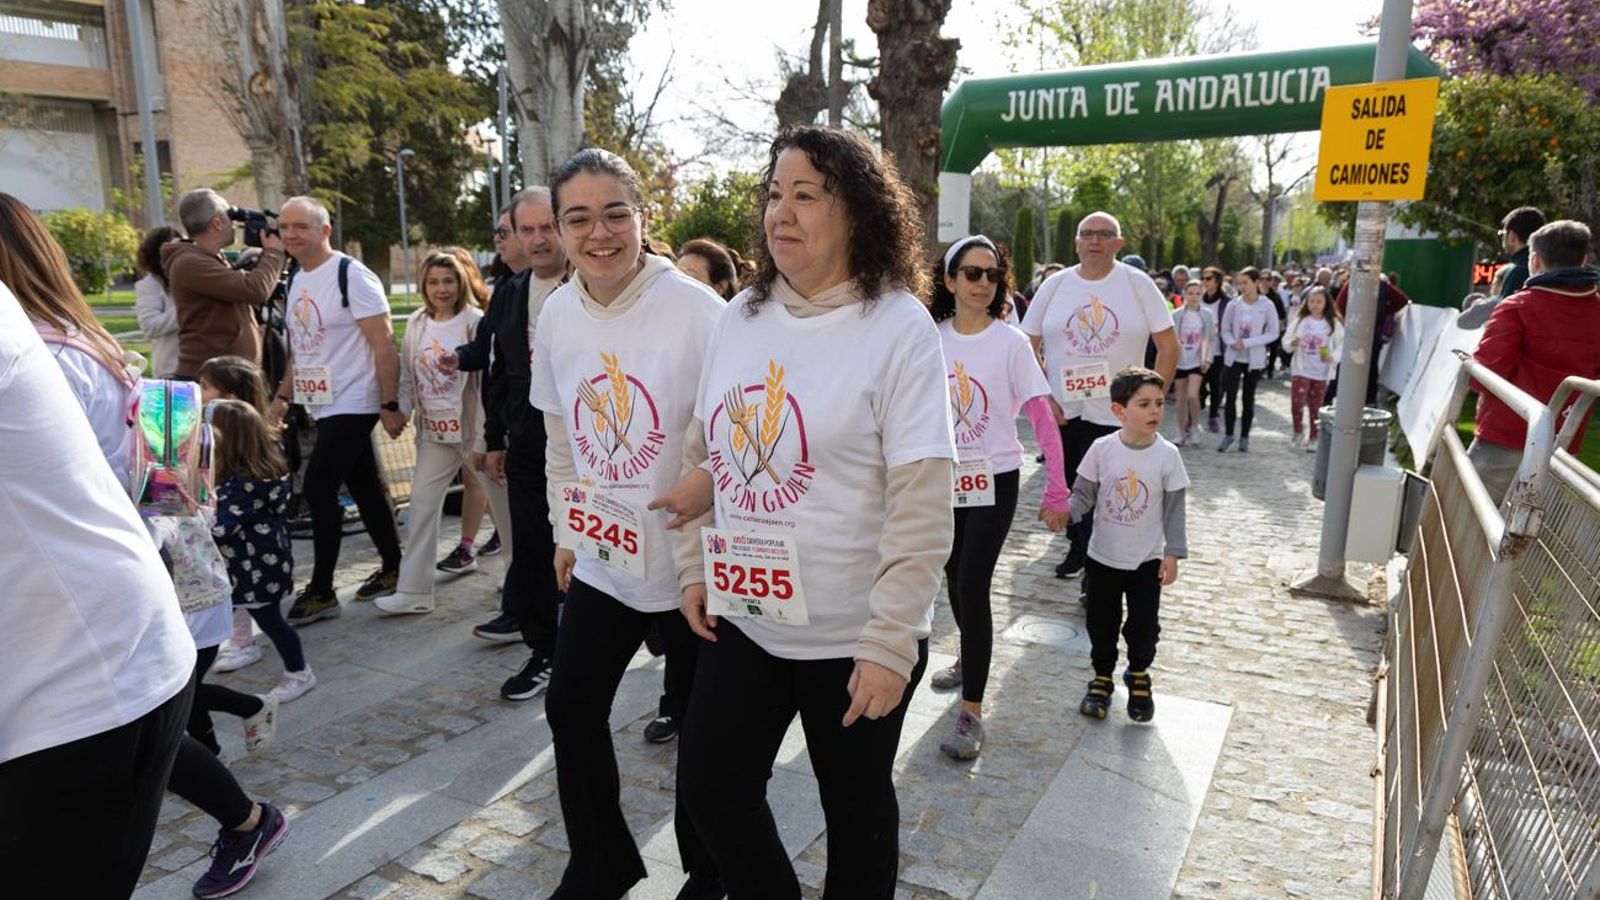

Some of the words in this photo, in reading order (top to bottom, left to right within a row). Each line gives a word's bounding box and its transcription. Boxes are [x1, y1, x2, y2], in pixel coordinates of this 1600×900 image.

[1001, 86, 1088, 122] JUNTA
[1104, 82, 1140, 117] DE
[1352, 95, 1406, 119] SALIDA
[1365, 128, 1385, 150] DE
[1330, 162, 1410, 185] CAMIONES
[295, 380, 327, 393] 5304
[1066, 375, 1107, 392] 5254
[424, 419, 459, 432] 5303
[598, 460, 618, 481] SIN
[730, 484, 756, 512] SIN
[568, 508, 638, 555] 5245
[713, 561, 793, 600] 5255
